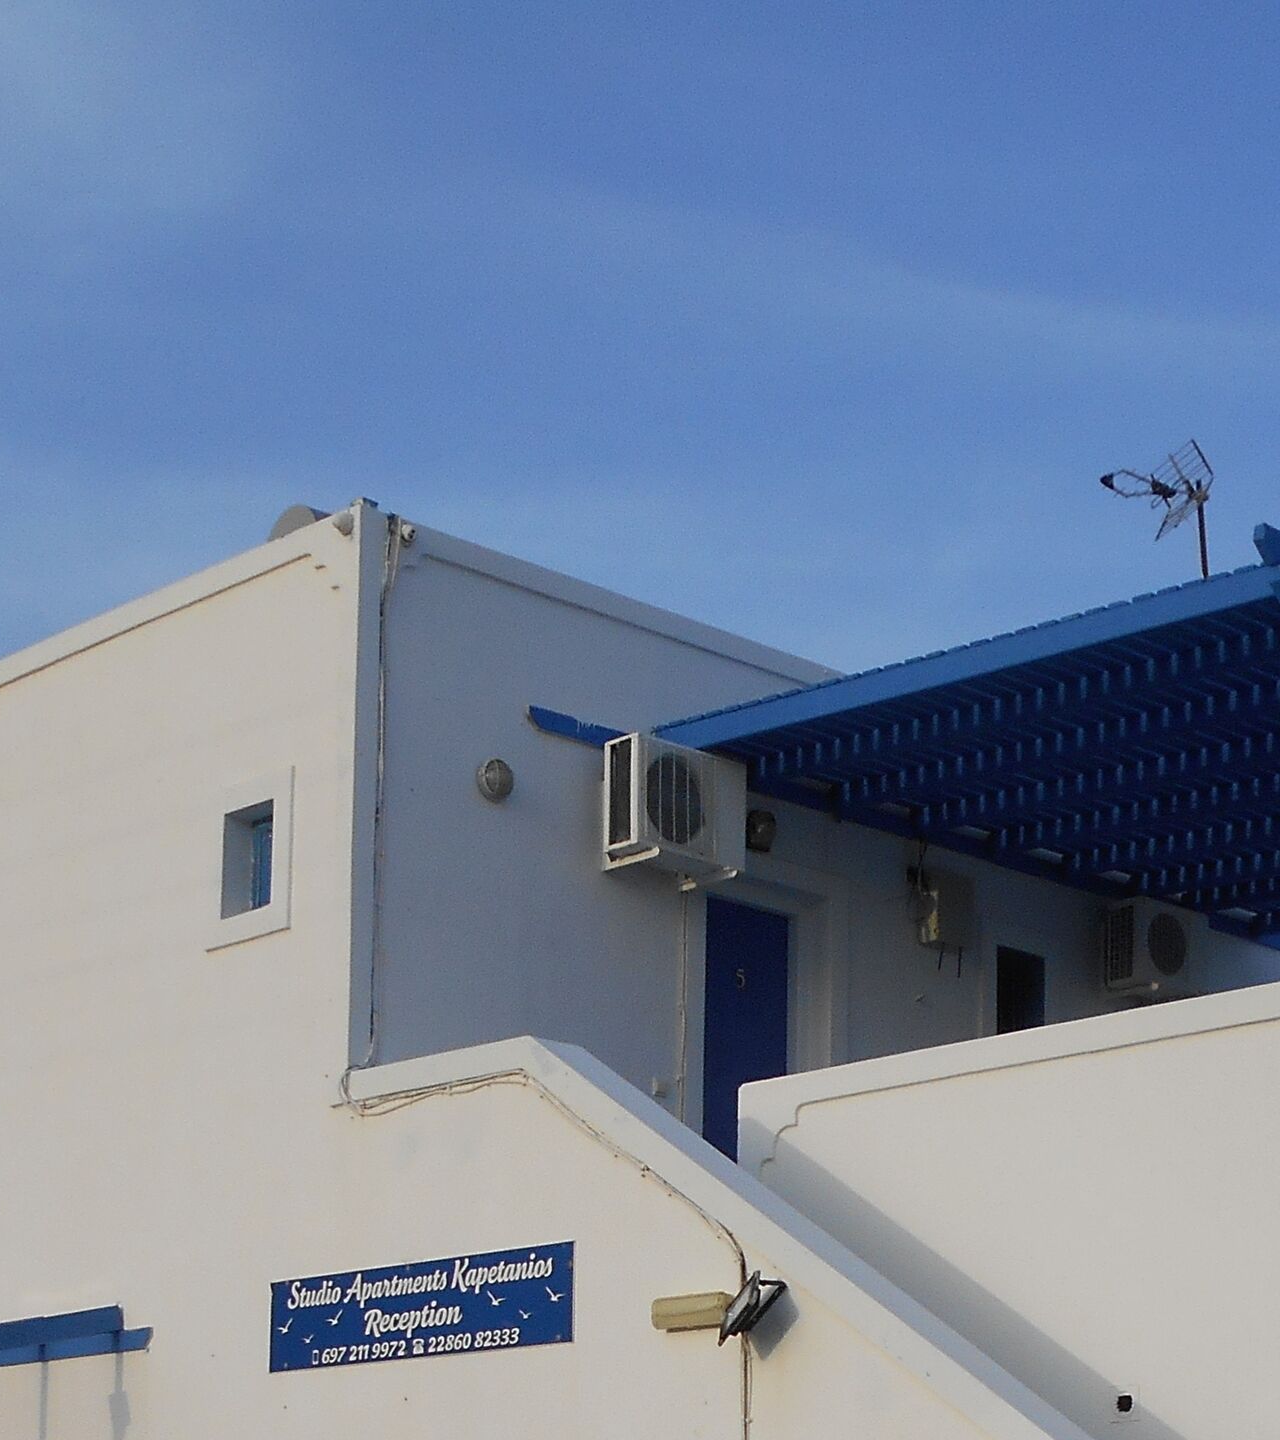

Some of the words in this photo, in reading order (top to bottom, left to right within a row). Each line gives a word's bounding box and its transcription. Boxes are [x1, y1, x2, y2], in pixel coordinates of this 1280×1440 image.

[287, 1280, 342, 1310] Studio
[343, 1271, 449, 1309] Apartments
[450, 1252, 555, 1295] Kapetanios
[363, 1299, 464, 1339] Reception
[321, 1348, 347, 1366] 697
[349, 1346, 370, 1362] 211
[370, 1341, 407, 1361] 9972
[427, 1334, 471, 1354] 22860
[474, 1327, 521, 1348] 82333
